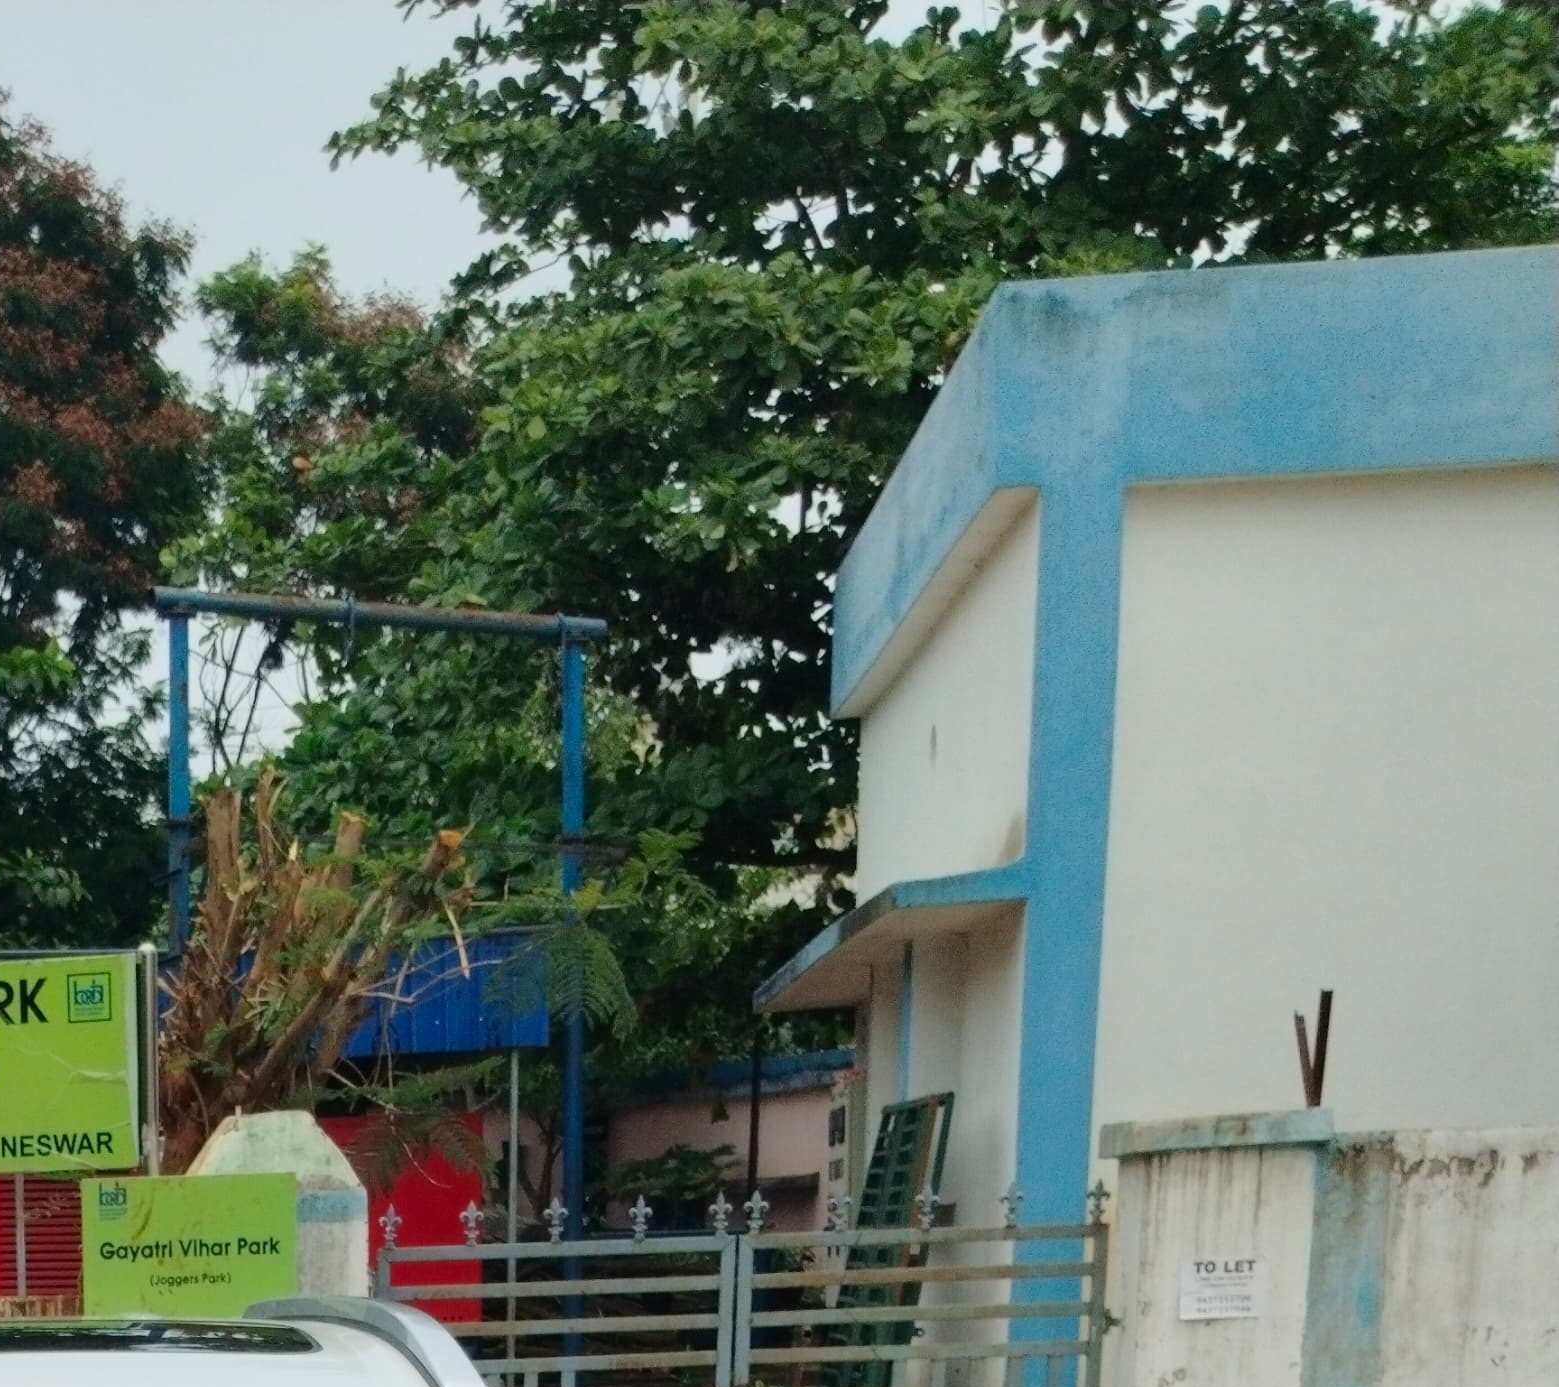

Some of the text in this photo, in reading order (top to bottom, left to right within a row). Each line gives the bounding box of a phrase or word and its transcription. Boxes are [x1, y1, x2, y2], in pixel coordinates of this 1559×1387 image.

[100, 1237, 281, 1263] Gayatri Vihar Park
[1193, 1259, 1256, 1274] TO LET
[150, 1272, 232, 1287] (Joggers Park)
